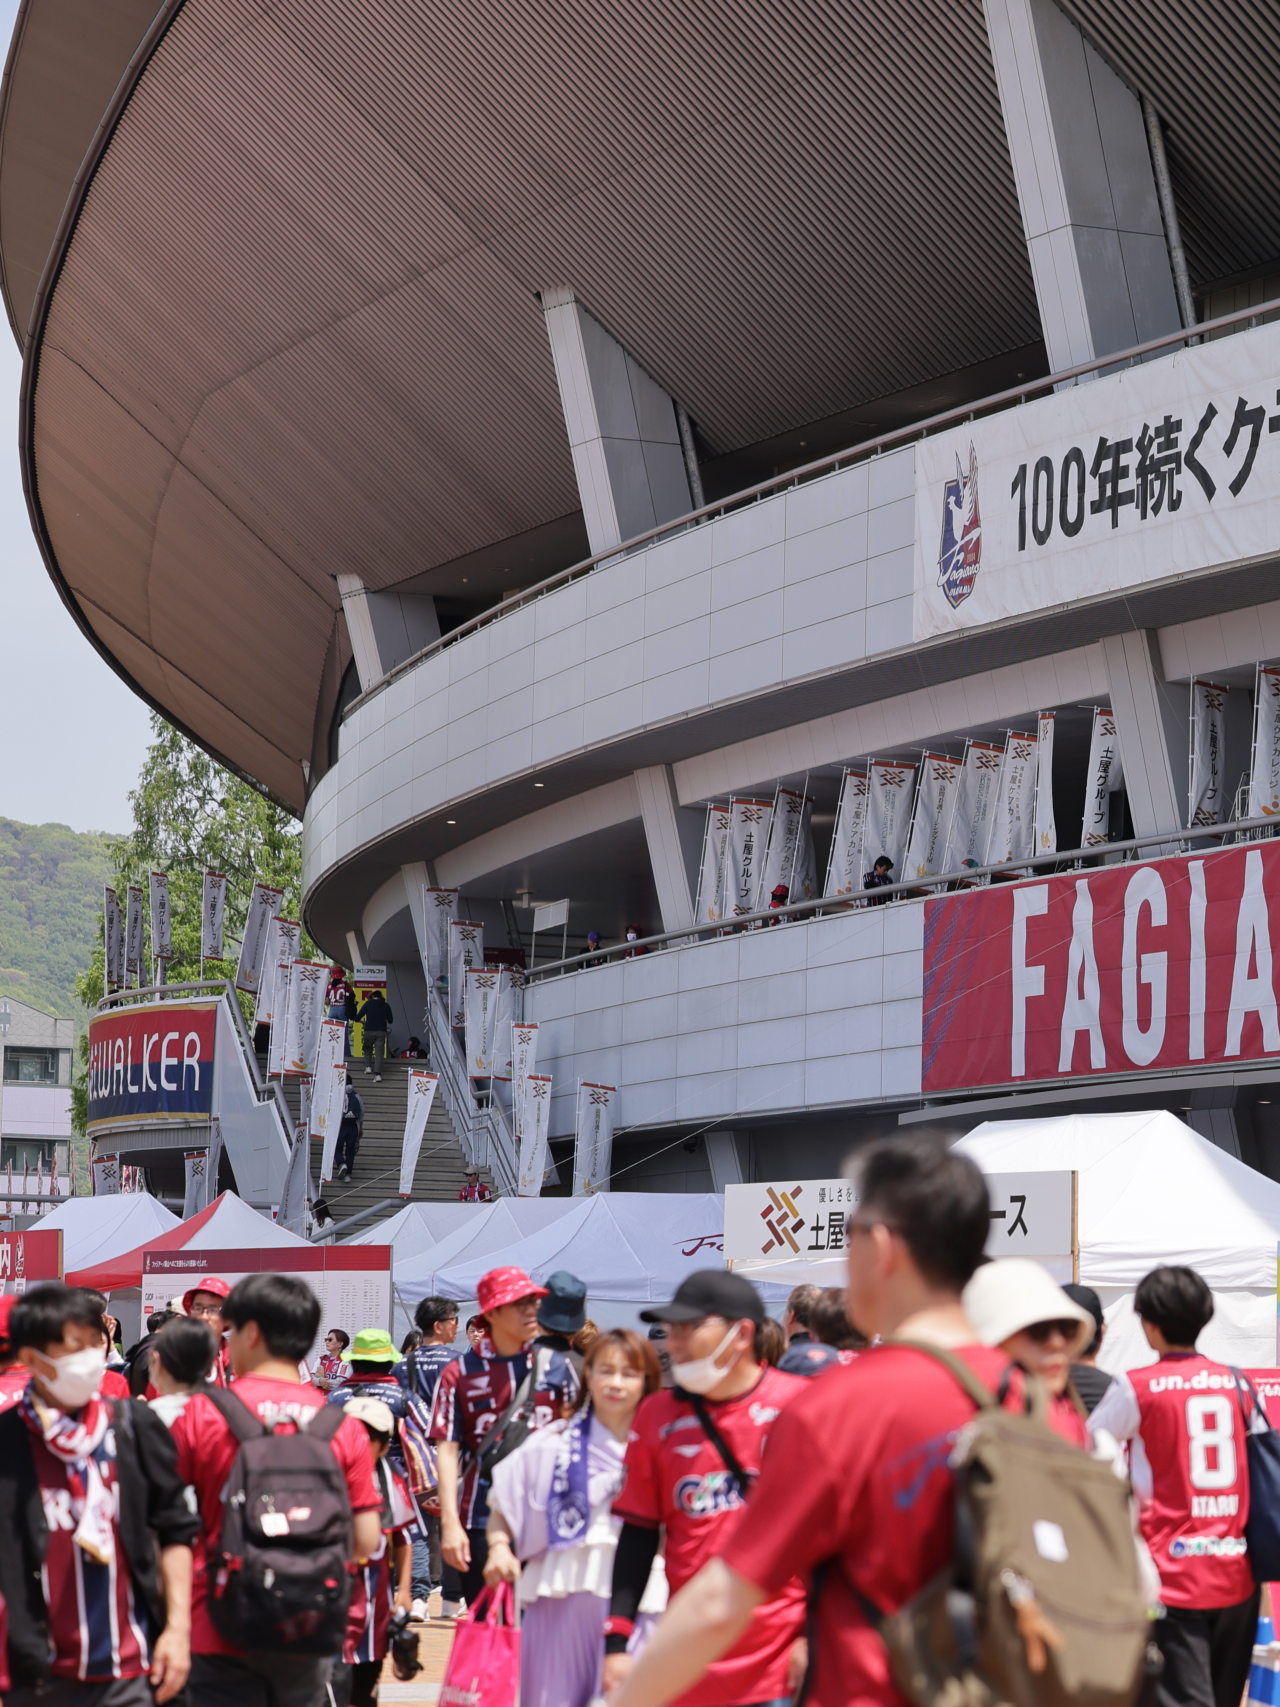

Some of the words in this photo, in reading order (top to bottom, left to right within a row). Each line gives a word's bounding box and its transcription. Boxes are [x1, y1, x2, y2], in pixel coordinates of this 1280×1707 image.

[1093, 746, 1114, 824] 土屋グループ
[1206, 720, 1219, 800] 土屋グループ
[740, 832, 754, 898] 土屋グループ
[780, 819, 794, 885] 土屋ケアカレッ
[844, 802, 863, 876] 土屋ケアカレッジ
[89, 1031, 200, 1100] iWALKER
[807, 1211, 851, 1250] 土屋
[1186, 1394, 1237, 1489] 8
[1191, 1494, 1239, 1518] ATARU
